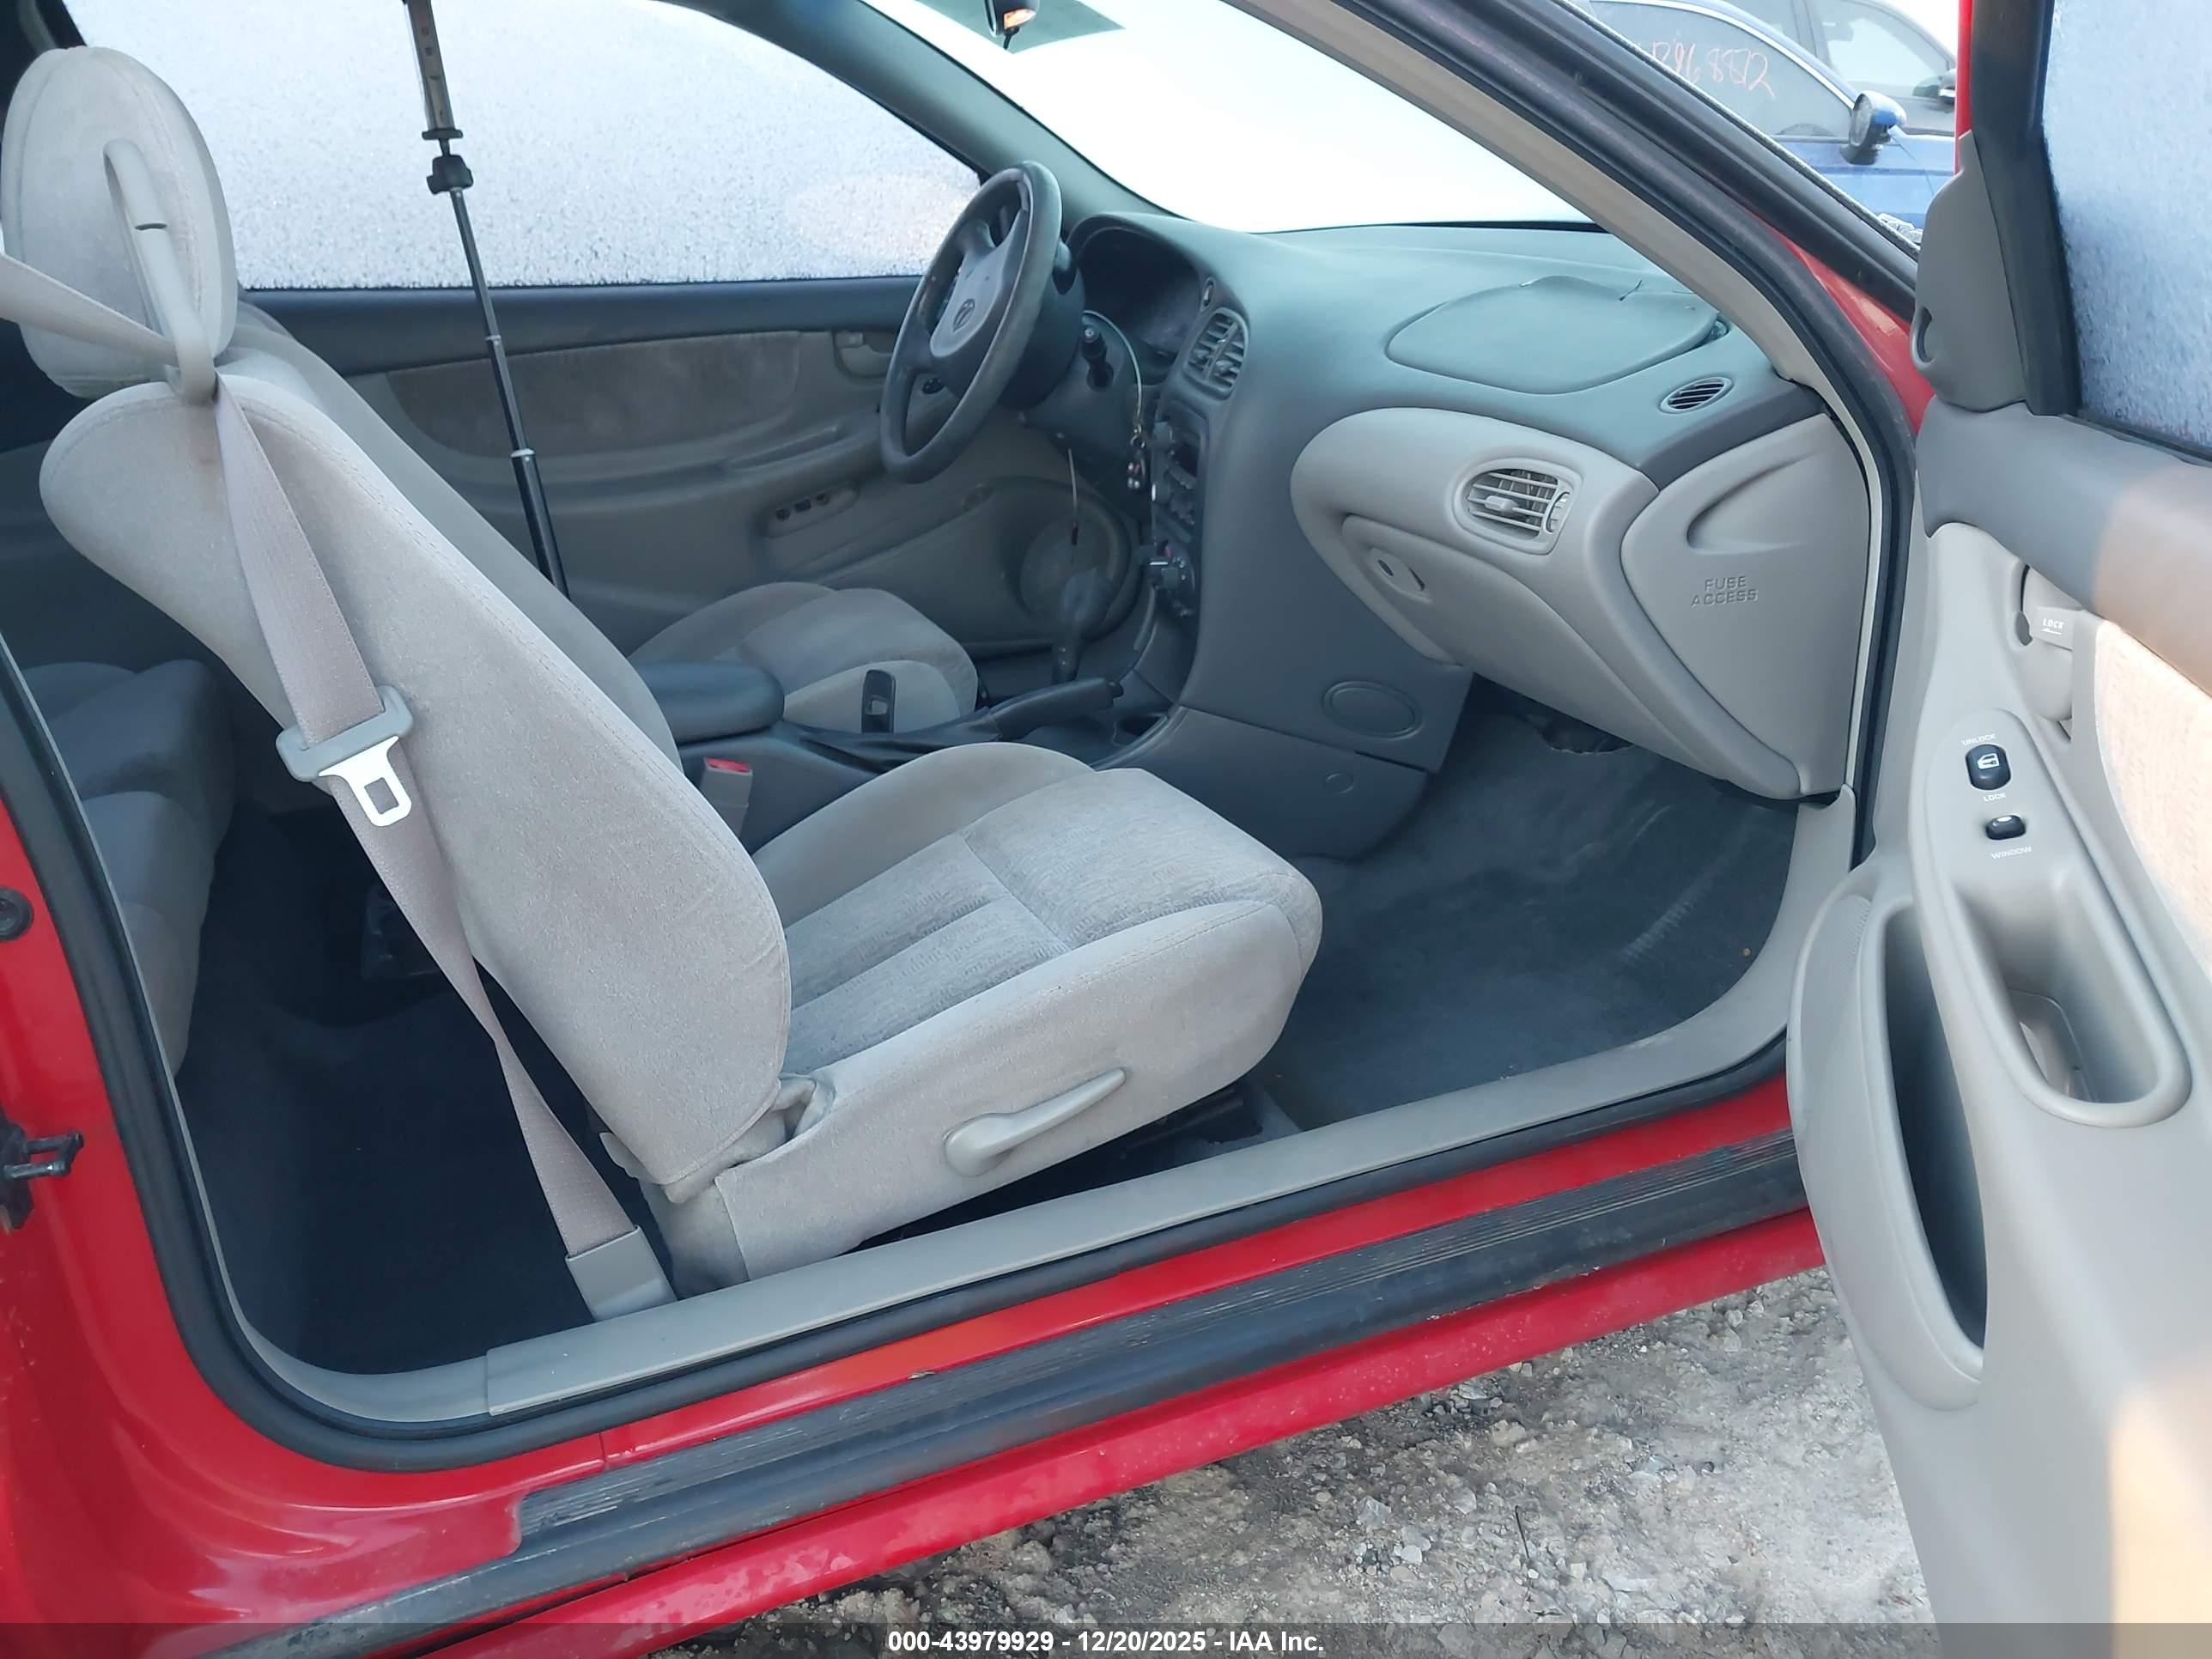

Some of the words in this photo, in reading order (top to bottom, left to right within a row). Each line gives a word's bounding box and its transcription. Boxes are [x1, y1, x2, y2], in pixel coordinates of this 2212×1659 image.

[1705, 575, 1747, 591] FUSE
[1692, 589, 1758, 607] ACCESS
[2042, 617, 2064, 629] LOCK
[1960, 733, 1996, 746] UNLOCK
[1983, 793, 2006, 802] LOCK
[1990, 846, 2032, 860] WINDOW
